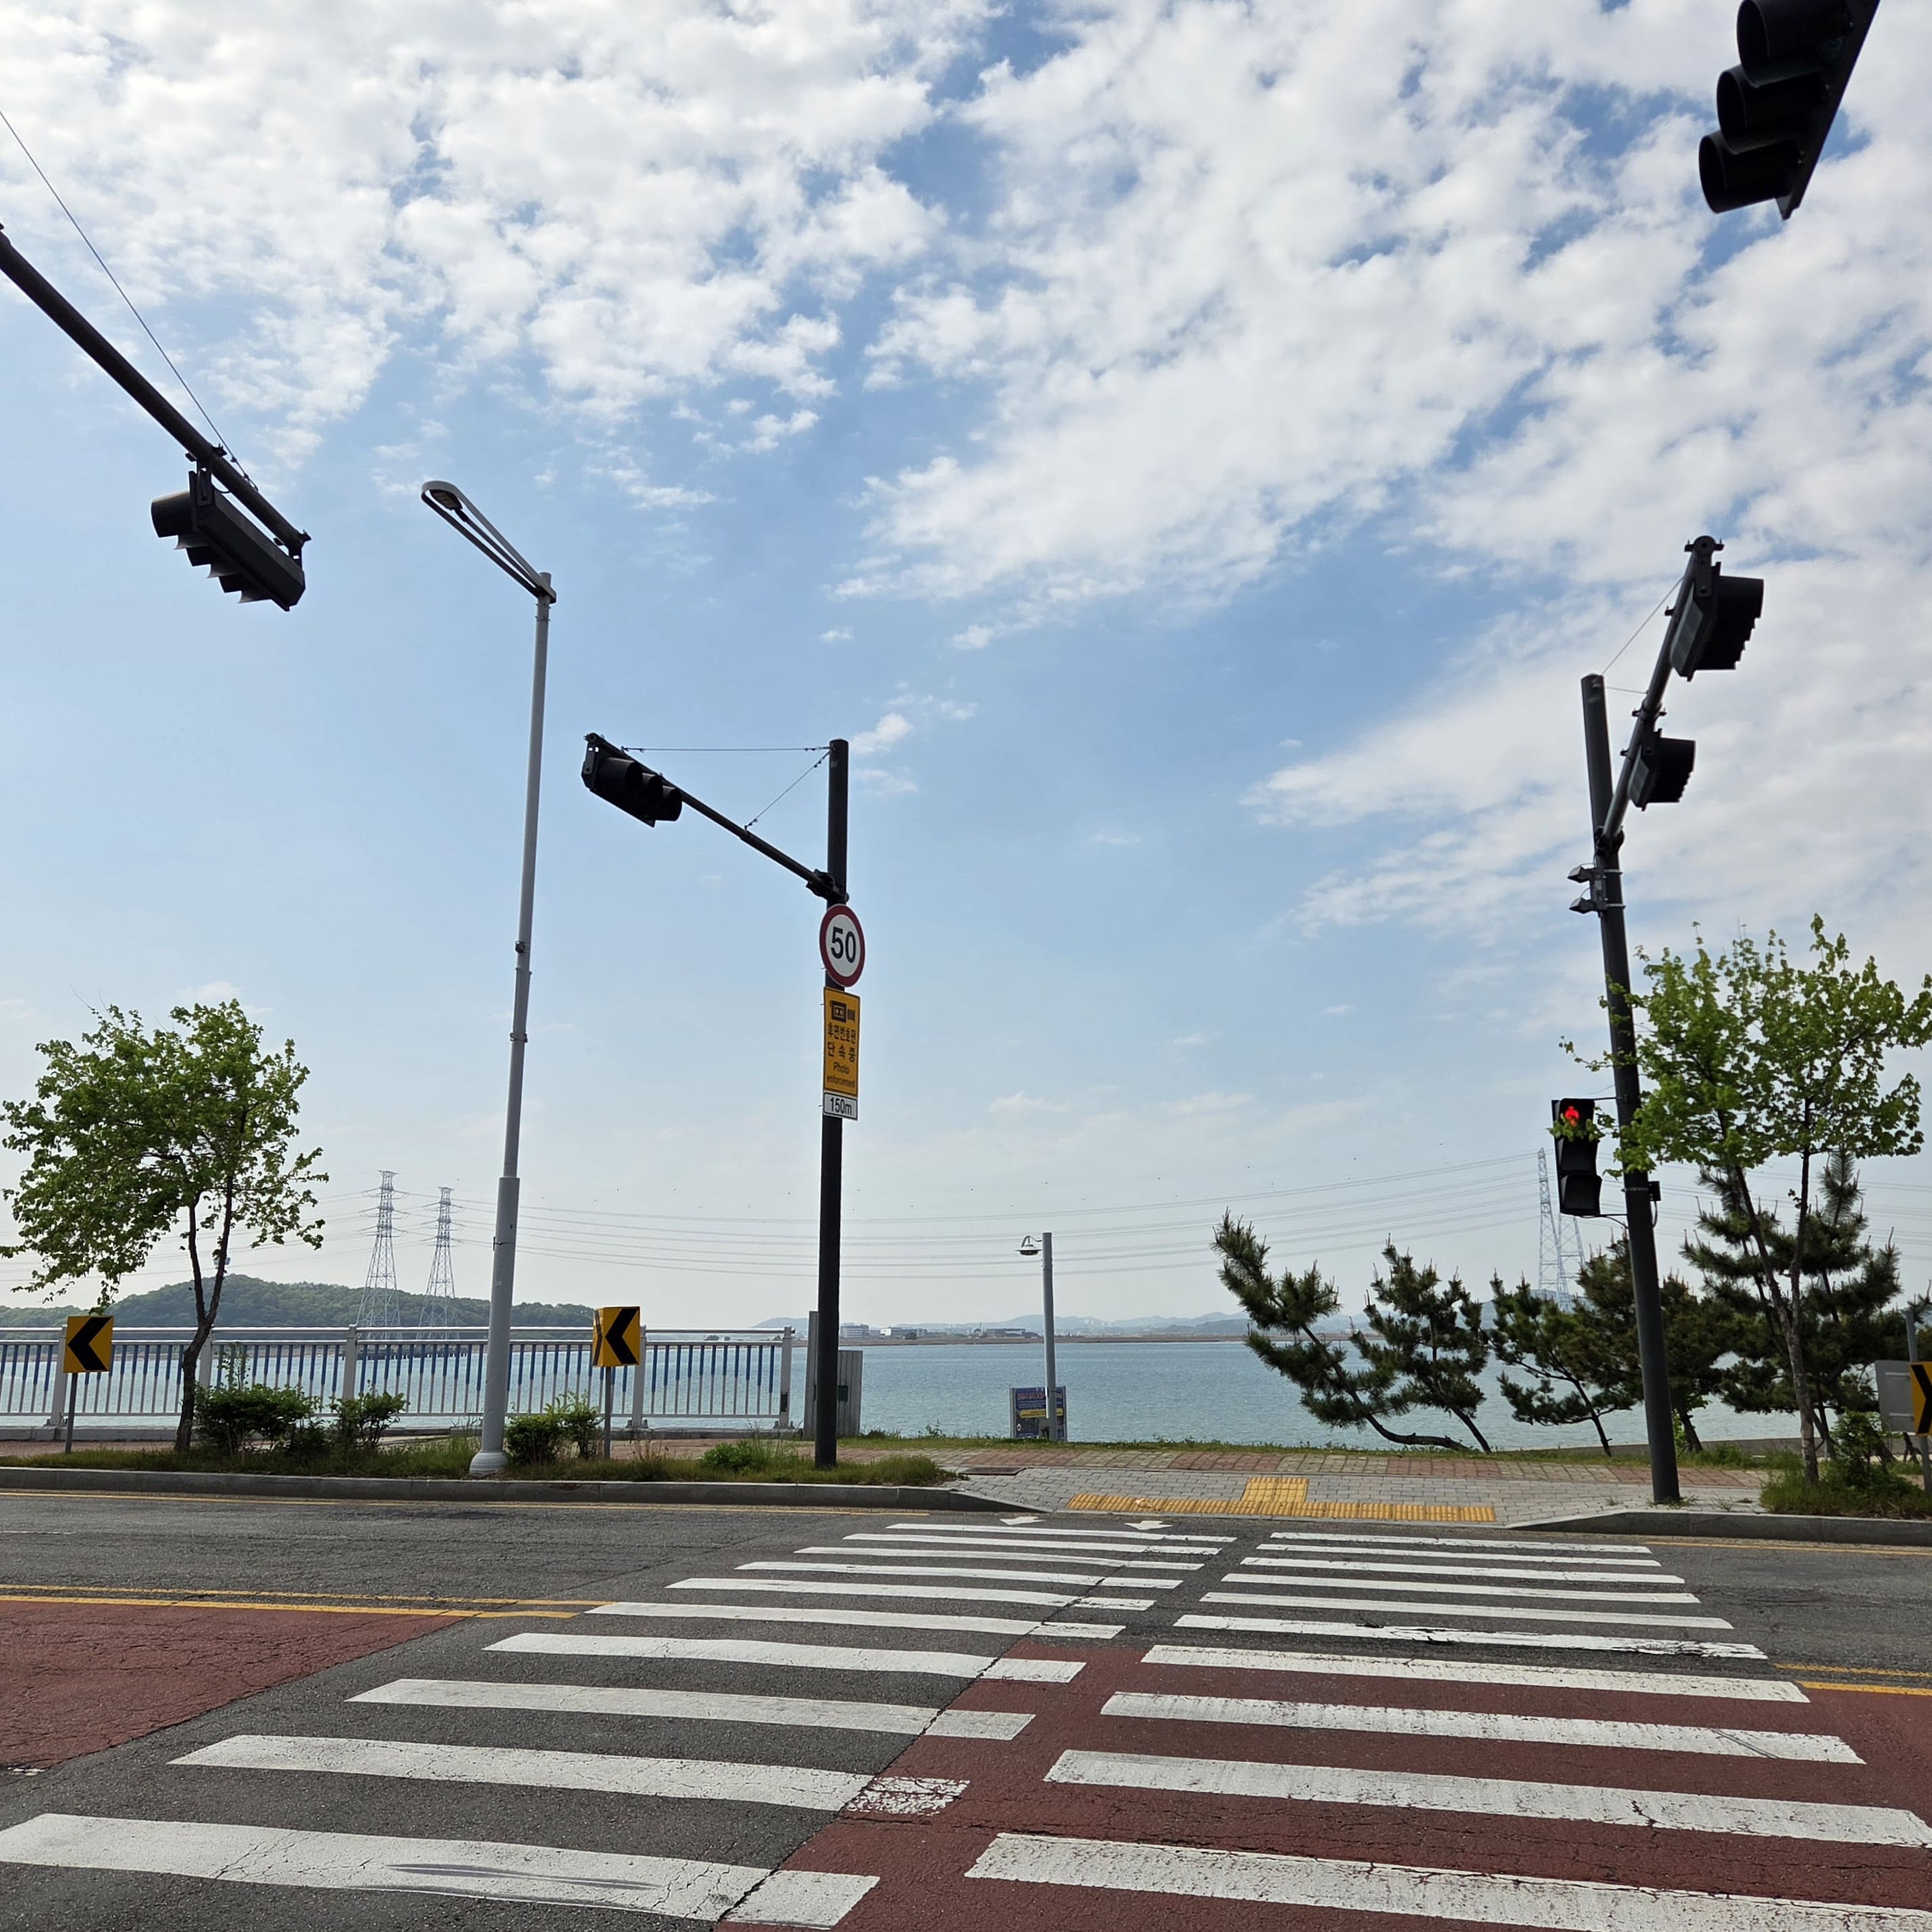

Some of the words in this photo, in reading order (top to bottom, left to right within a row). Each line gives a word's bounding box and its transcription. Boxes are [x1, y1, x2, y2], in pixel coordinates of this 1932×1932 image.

[831, 926, 856, 963] 50
[827, 1022, 856, 1045] 후면번호판
[834, 1061, 849, 1075] Photo
[831, 1097, 852, 1116] 150m
